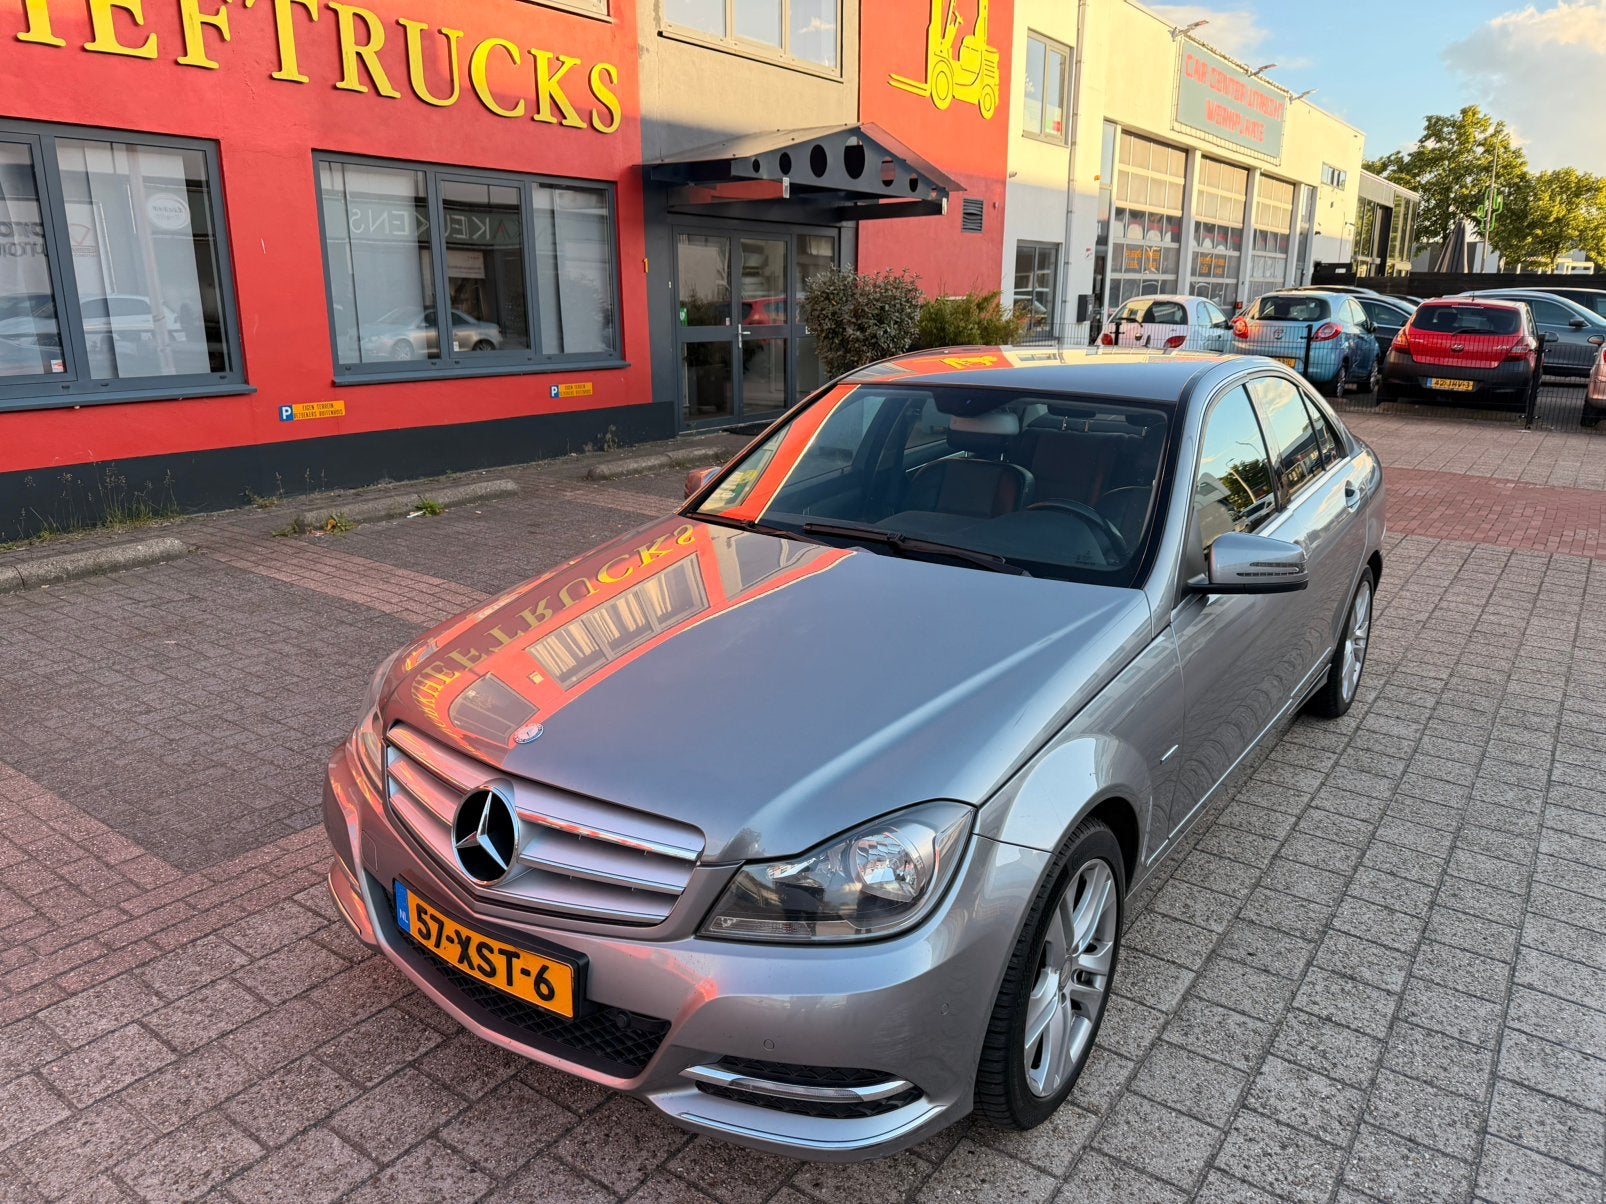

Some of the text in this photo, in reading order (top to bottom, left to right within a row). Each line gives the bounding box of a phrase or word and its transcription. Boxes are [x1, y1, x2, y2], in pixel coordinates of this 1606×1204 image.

[15, 0, 622, 135] EFTRUCKS
[399, 909, 409, 924] NL
[416, 903, 556, 1002] 57-XST-6
